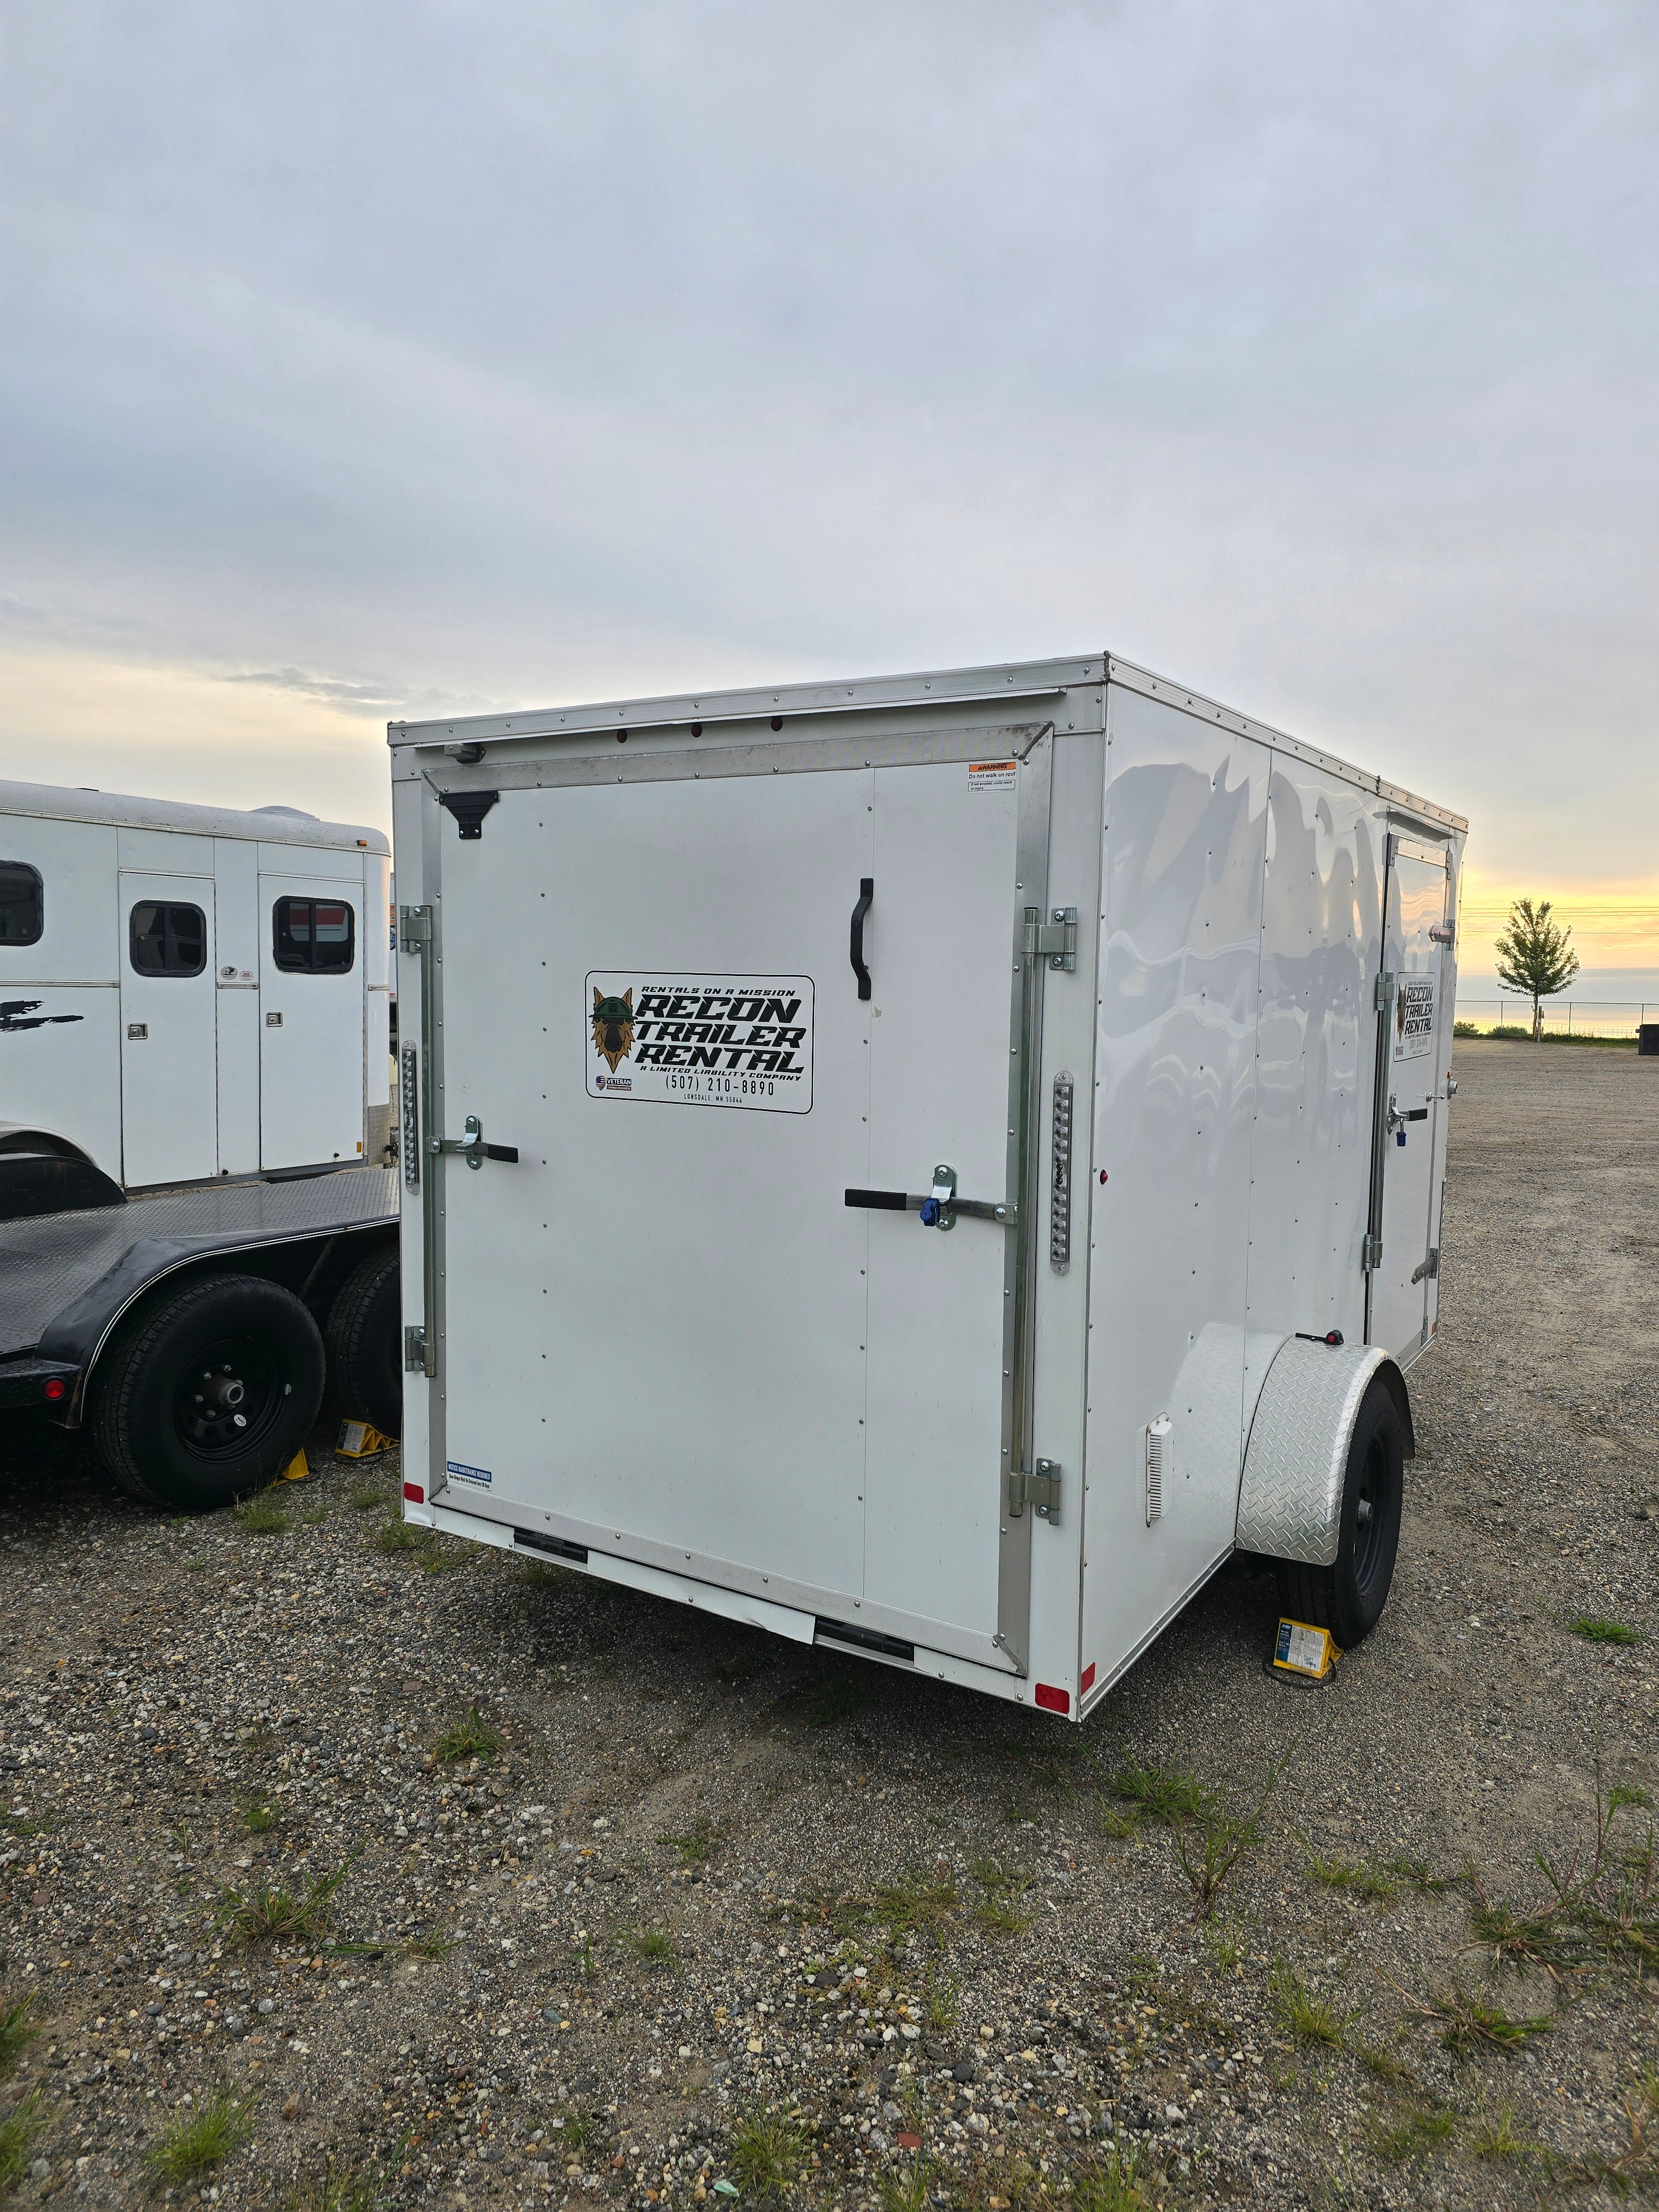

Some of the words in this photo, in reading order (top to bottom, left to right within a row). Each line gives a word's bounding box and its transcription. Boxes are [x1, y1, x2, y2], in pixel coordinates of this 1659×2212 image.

[1406, 987, 1433, 1003] RECON
[635, 994, 802, 1023] RECON
[1406, 1003, 1433, 1019] TRAILER
[635, 1021, 807, 1048] TRAILER
[1405, 1018, 1432, 1035] RENTAL
[634, 1044, 805, 1073] RENTAL
[693, 1069, 746, 1077] LIABILITY
[749, 1072, 801, 1081] COMPANY
[666, 1074, 700, 1092] (507)
[708, 1077, 774, 1095] 210-8890
[448, 1463, 458, 1472] NOTICE
[458, 1465, 477, 1477] MAINTENANCE
[477, 1470, 491, 1480] REQUIRED
